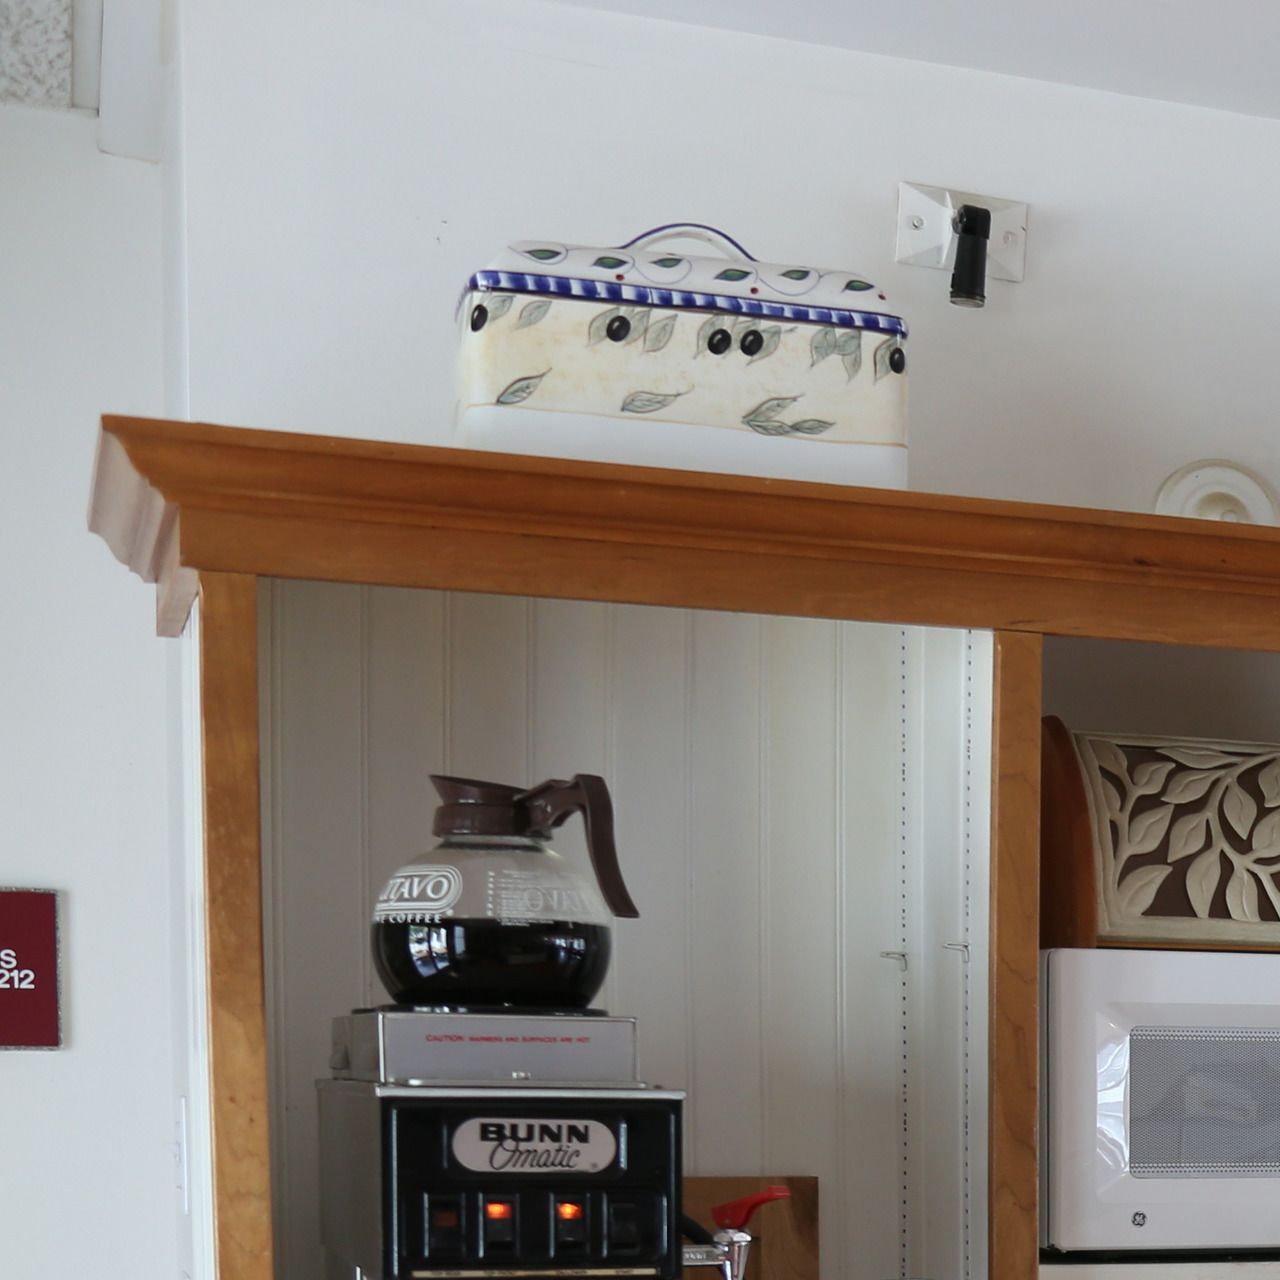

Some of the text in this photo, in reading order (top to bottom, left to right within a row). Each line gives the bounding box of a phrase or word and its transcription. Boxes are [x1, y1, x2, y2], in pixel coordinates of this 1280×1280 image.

[388, 913, 442, 923] COFFEE
[0, 949, 17, 969] S
[480, 1123, 589, 1143] BUNN
[489, 1138, 580, 1170] Omatic
